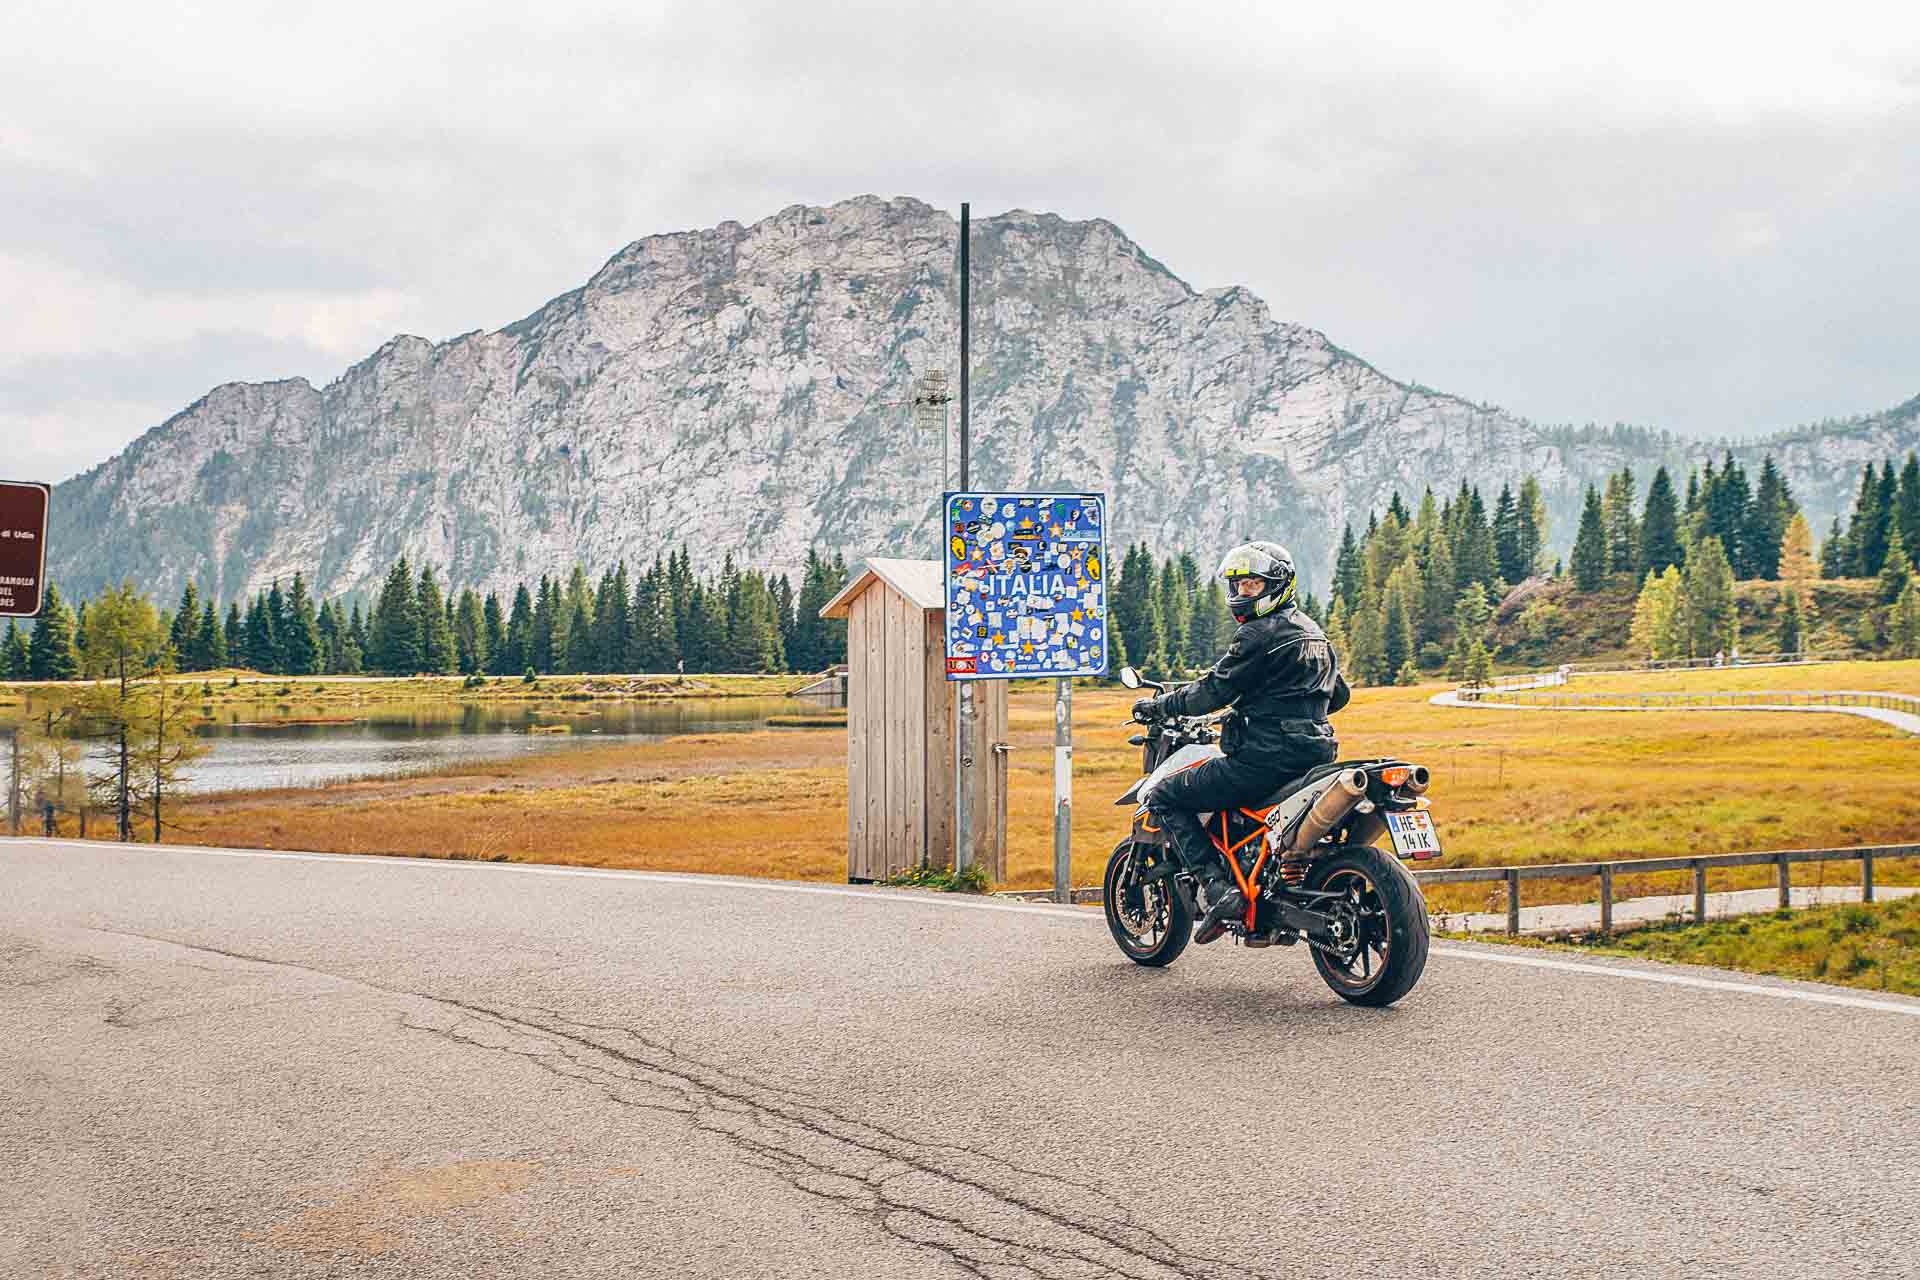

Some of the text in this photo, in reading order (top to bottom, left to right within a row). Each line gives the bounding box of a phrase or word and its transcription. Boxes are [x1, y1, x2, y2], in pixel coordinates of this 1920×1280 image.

[989, 574, 1066, 595] ITALIA
[1400, 816, 1416, 831] HE
[1403, 833, 1431, 849] 14 IK
